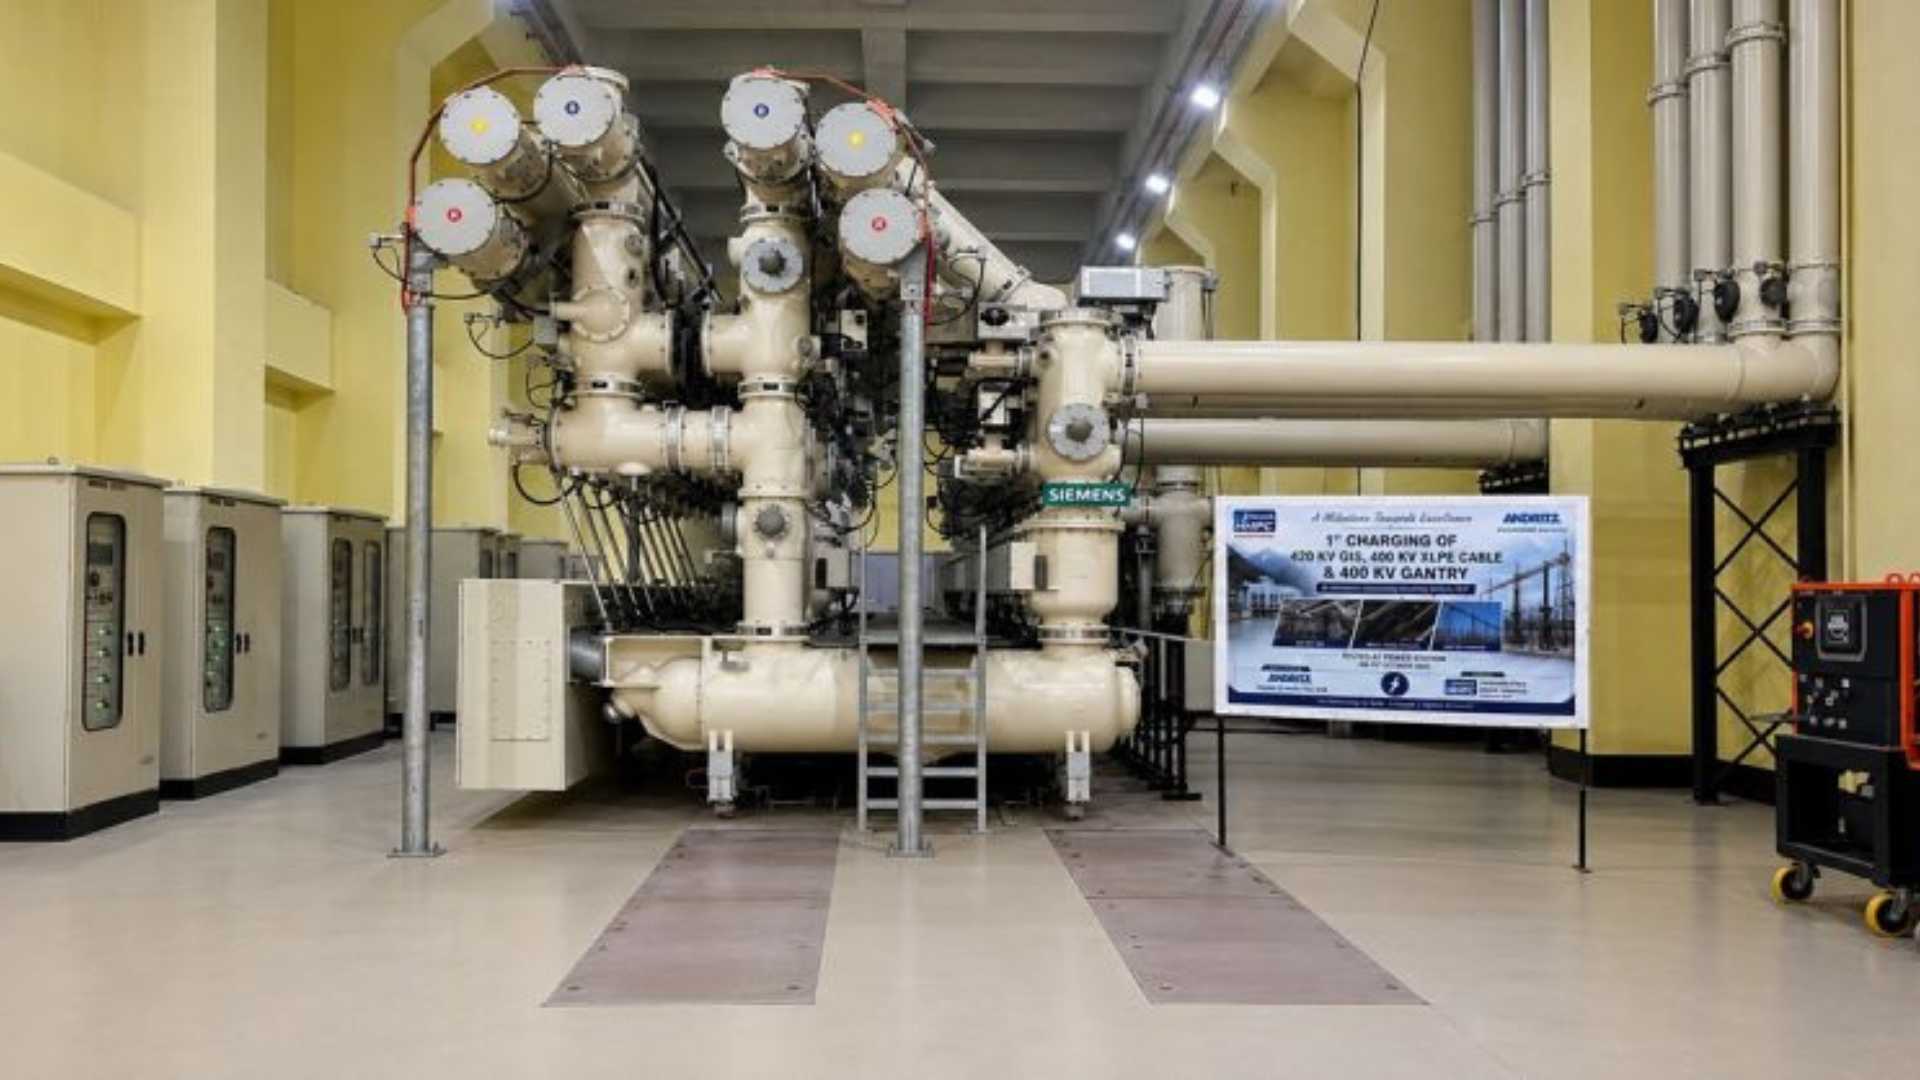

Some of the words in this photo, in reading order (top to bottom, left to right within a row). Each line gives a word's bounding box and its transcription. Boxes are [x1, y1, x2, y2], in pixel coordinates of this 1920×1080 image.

[1048, 487, 1126, 502] SIEMENS
[1375, 510, 1415, 523] Towards
[1419, 511, 1472, 523] Excellence
[1502, 512, 1561, 524] ANDRITZ
[1346, 534, 1431, 547] CHARGING
[1436, 534, 1457, 547] OF
[1290, 550, 1315, 562] 420
[1317, 550, 1335, 562] KV
[1339, 550, 1366, 564] GIS,
[1371, 551, 1395, 563] 400
[1398, 551, 1417, 563] KV
[1420, 551, 1455, 564] XLPE
[1458, 552, 1502, 564] CABLE
[1323, 566, 1335, 579] &
[1340, 566, 1369, 579] 400
[1373, 567, 1396, 579] KV
[1401, 567, 1468, 579] GANTRY
